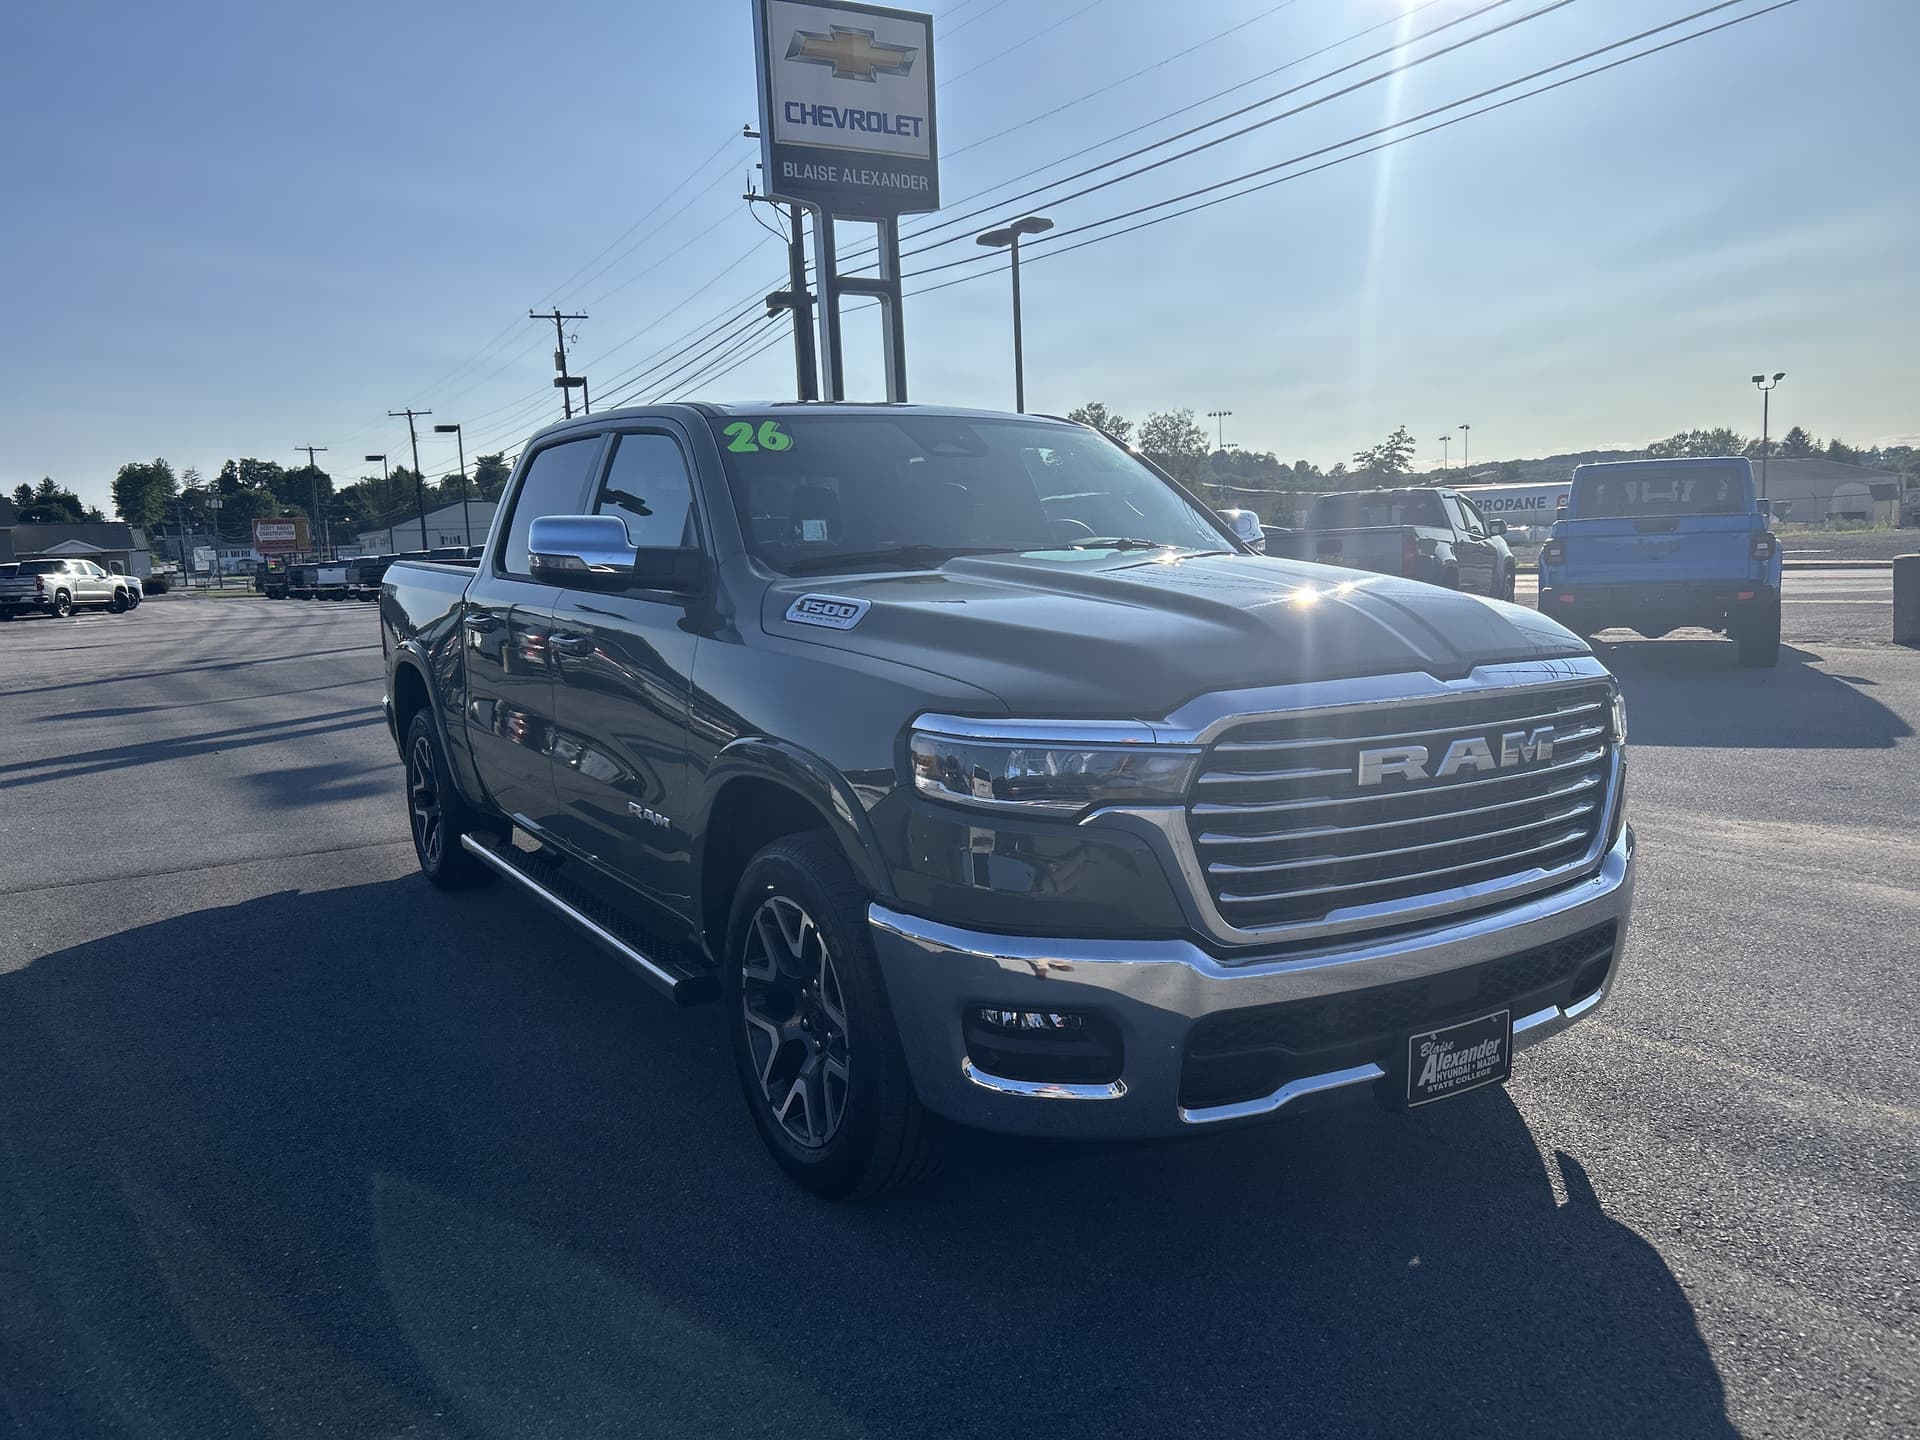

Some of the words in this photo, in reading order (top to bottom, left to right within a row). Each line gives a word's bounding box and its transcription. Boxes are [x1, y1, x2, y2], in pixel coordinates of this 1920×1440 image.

[784, 101, 923, 138] CHEVROLET
[783, 161, 838, 182] BLAISE
[842, 168, 929, 191] ALEXANDER
[723, 420, 794, 453] 26
[1475, 496, 1547, 511] PROPANE
[802, 601, 856, 618] 1500
[1358, 725, 1555, 786] RAM
[628, 801, 672, 832] RAM
[1417, 1038, 1502, 1087] Alexander
[1420, 1041, 1455, 1057] Blaise
[1427, 1081, 1454, 1093] STATE
[1456, 1067, 1492, 1085] COLLEGE
[1436, 1063, 1471, 1082] HYUNDAI
[1476, 1053, 1501, 1070] MAZDA
